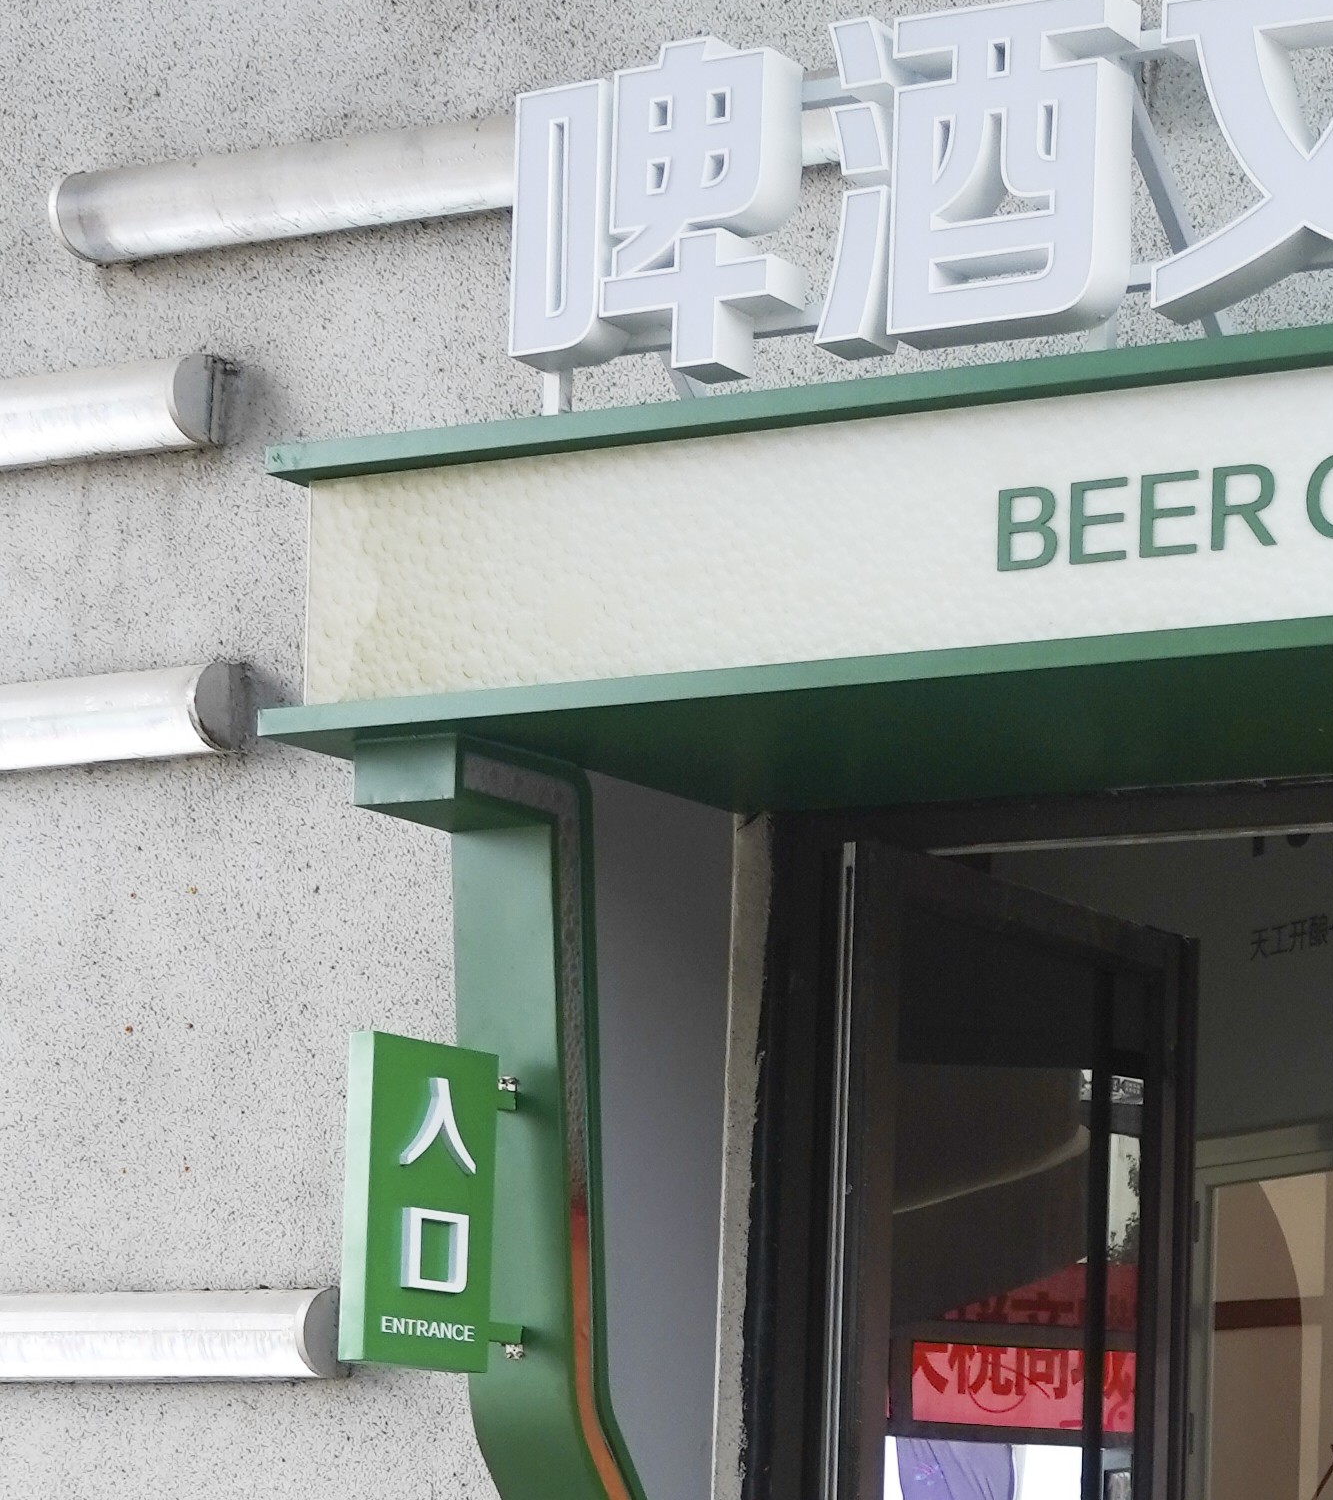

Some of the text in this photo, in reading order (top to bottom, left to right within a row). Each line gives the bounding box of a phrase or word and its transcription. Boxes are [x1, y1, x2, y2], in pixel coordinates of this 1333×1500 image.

[996, 460, 1279, 575] BEER
[400, 1077, 477, 1295] 入口
[381, 1315, 475, 1342] ENTRANCE
